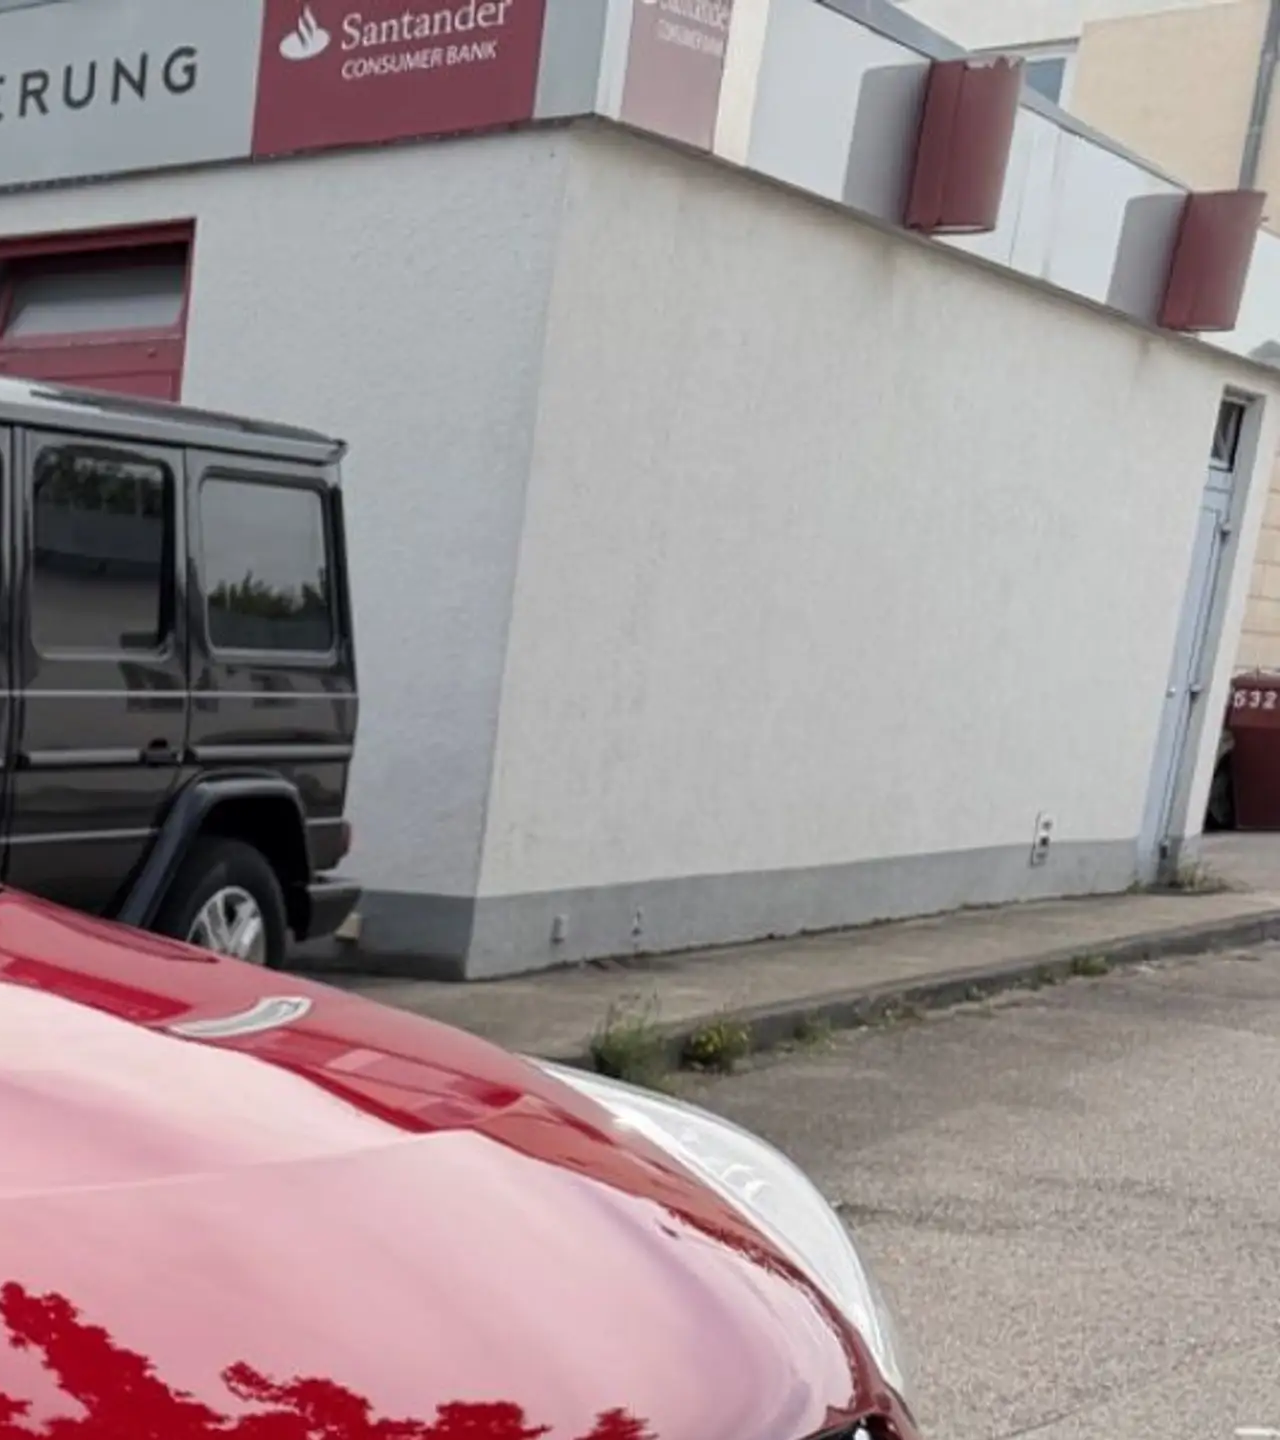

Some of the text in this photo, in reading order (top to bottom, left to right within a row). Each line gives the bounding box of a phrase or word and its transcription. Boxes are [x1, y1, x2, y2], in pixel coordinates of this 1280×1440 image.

[341, 0, 513, 51] Santander
[341, 41, 497, 80] CONSUMER BANK
